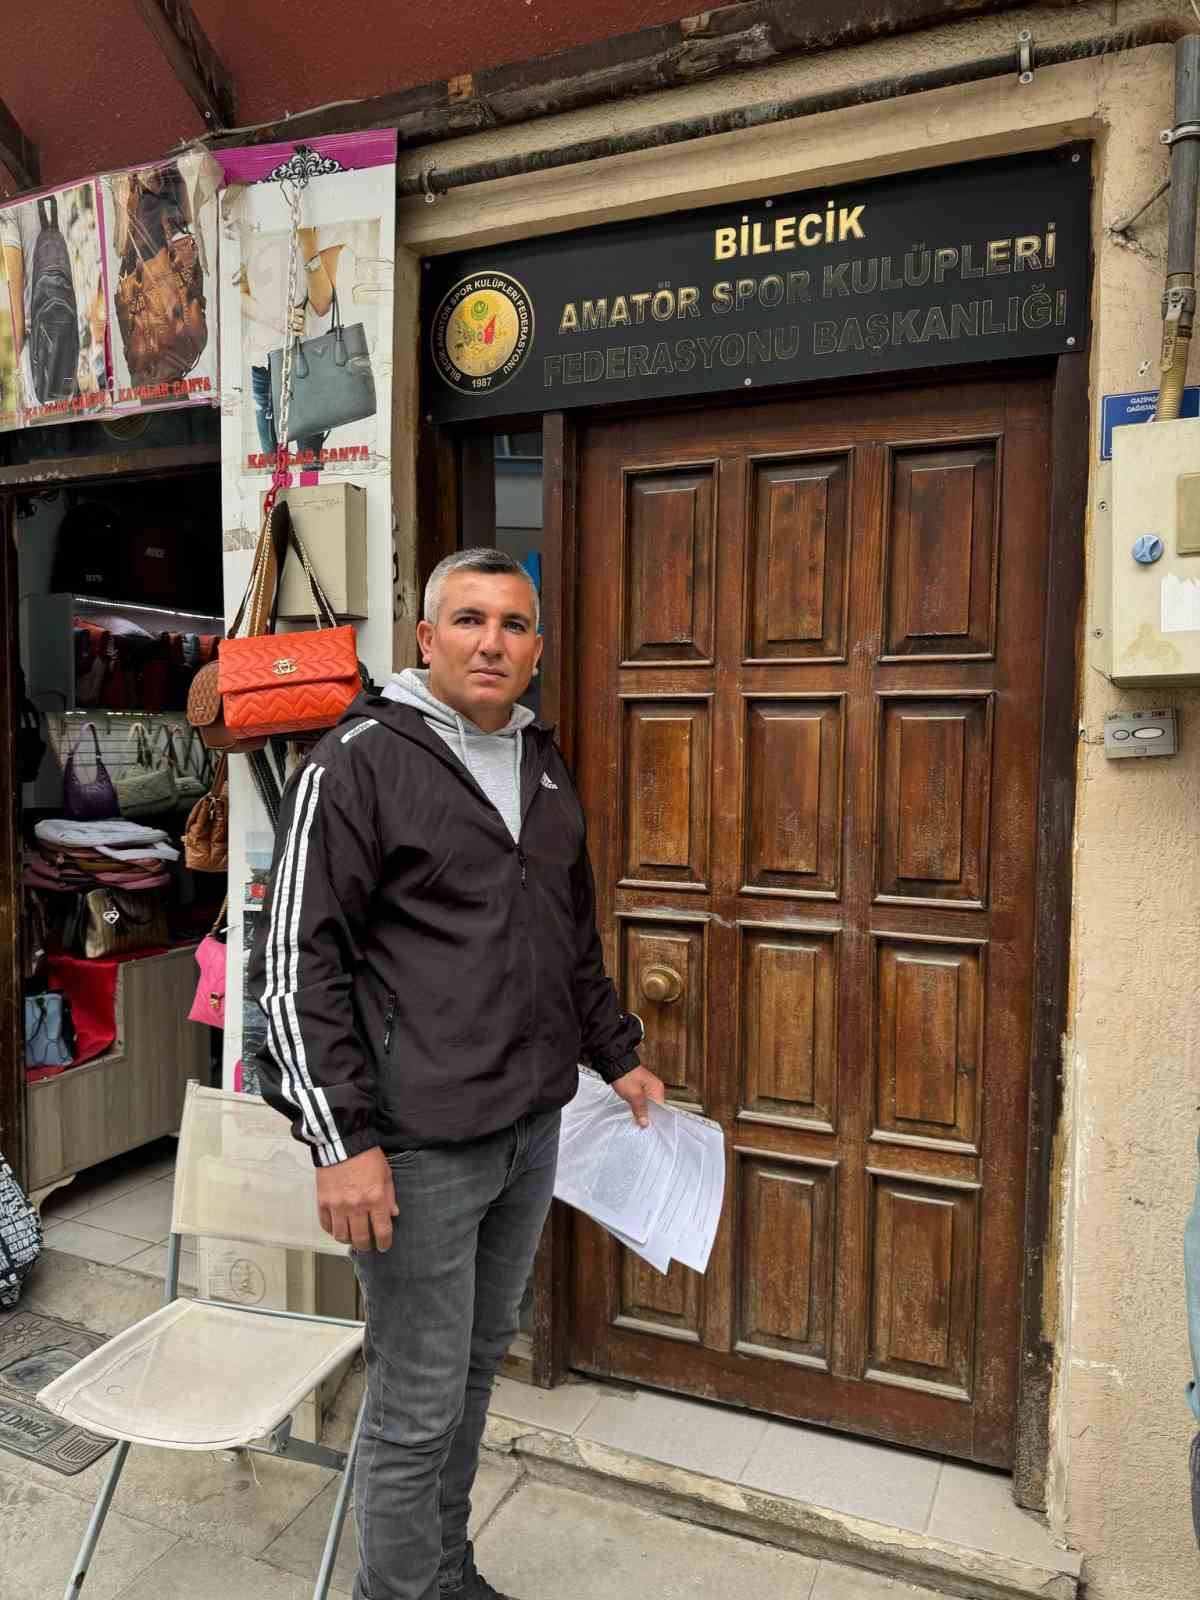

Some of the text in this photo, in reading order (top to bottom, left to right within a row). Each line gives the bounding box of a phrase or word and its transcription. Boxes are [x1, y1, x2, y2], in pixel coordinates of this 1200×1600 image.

[558, 221, 1057, 335] AMATÖR SPOR KULÜPLERİ
[714, 200, 866, 260] BİLECİK
[449, 283, 474, 306] SPOR
[474, 279, 520, 301] KULÜPLERİ
[503, 299, 529, 375] FEDERASYONU
[543, 284, 1068, 388] FEDERASYONU BAŞKANLIĞI
[471, 377, 492, 388] 1987
